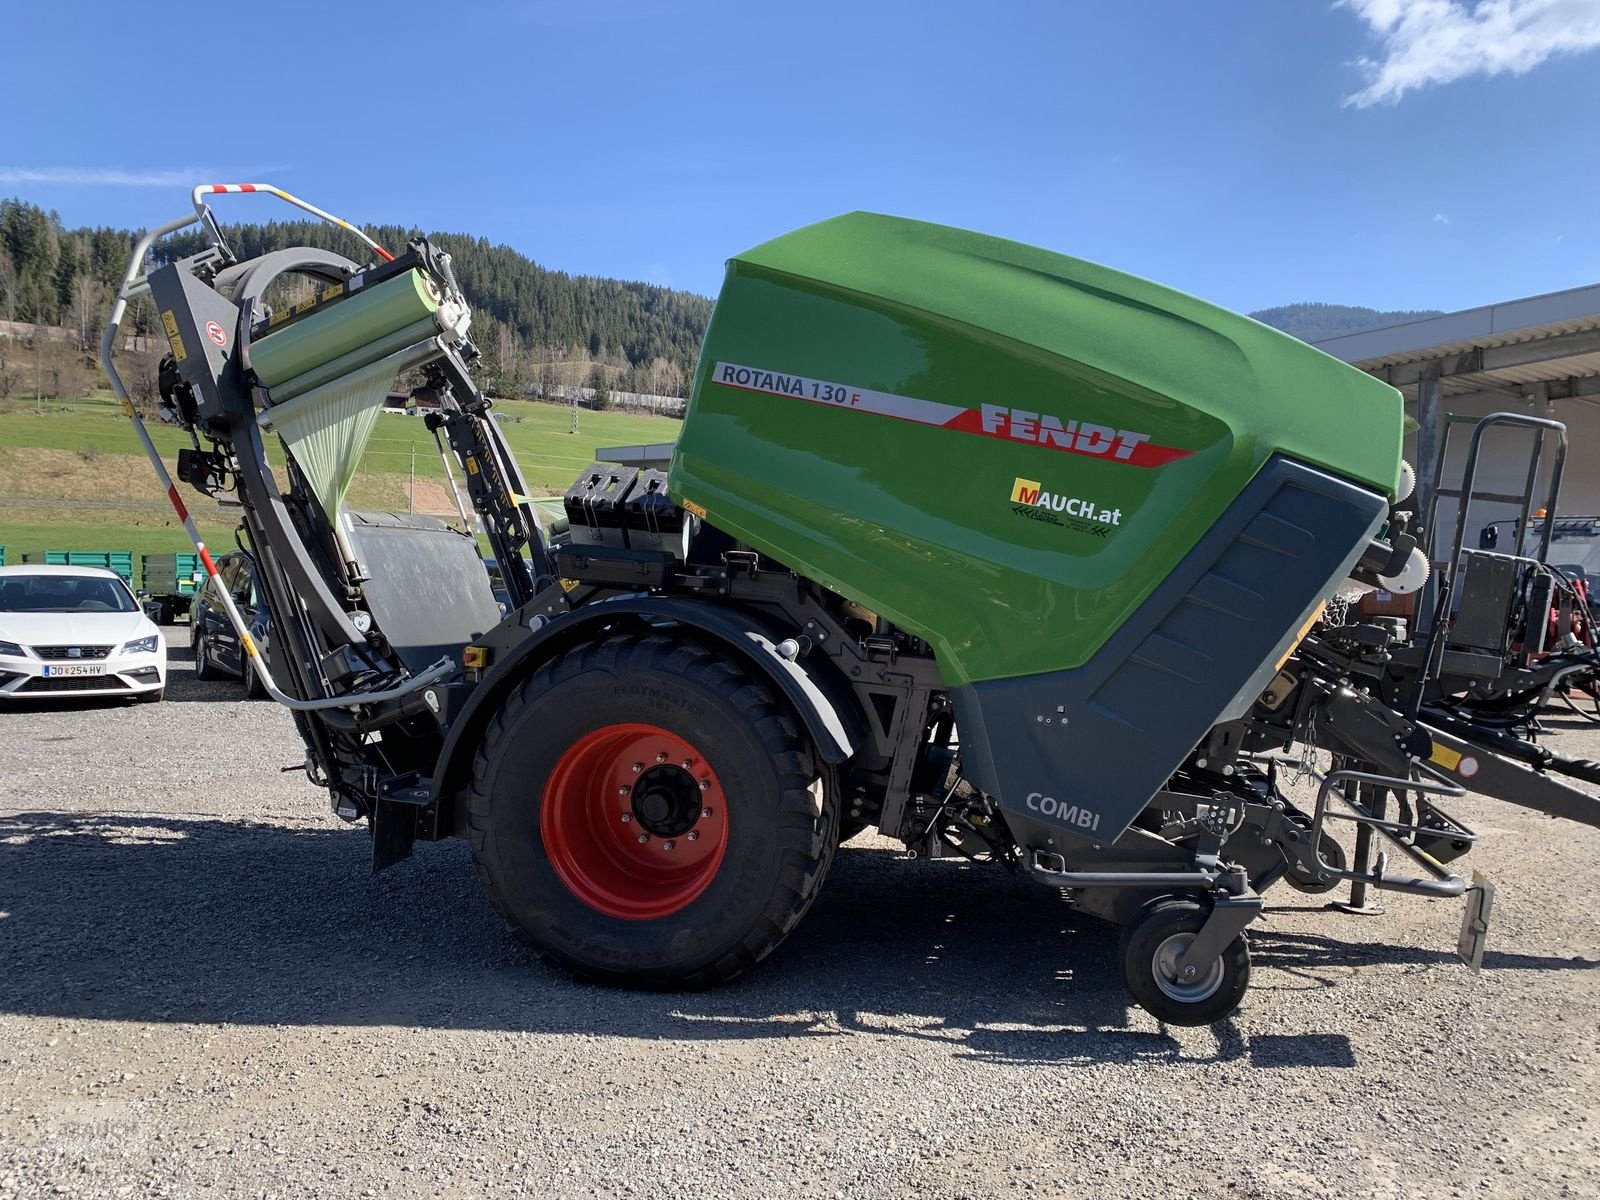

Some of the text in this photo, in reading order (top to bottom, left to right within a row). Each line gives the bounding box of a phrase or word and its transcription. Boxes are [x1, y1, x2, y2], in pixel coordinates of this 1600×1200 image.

[722, 365, 861, 406] ROTANA 130 F
[981, 403, 1151, 460] FENDT
[1018, 487, 1122, 526] MAUCH.at
[1026, 792, 1100, 831] COMBI
